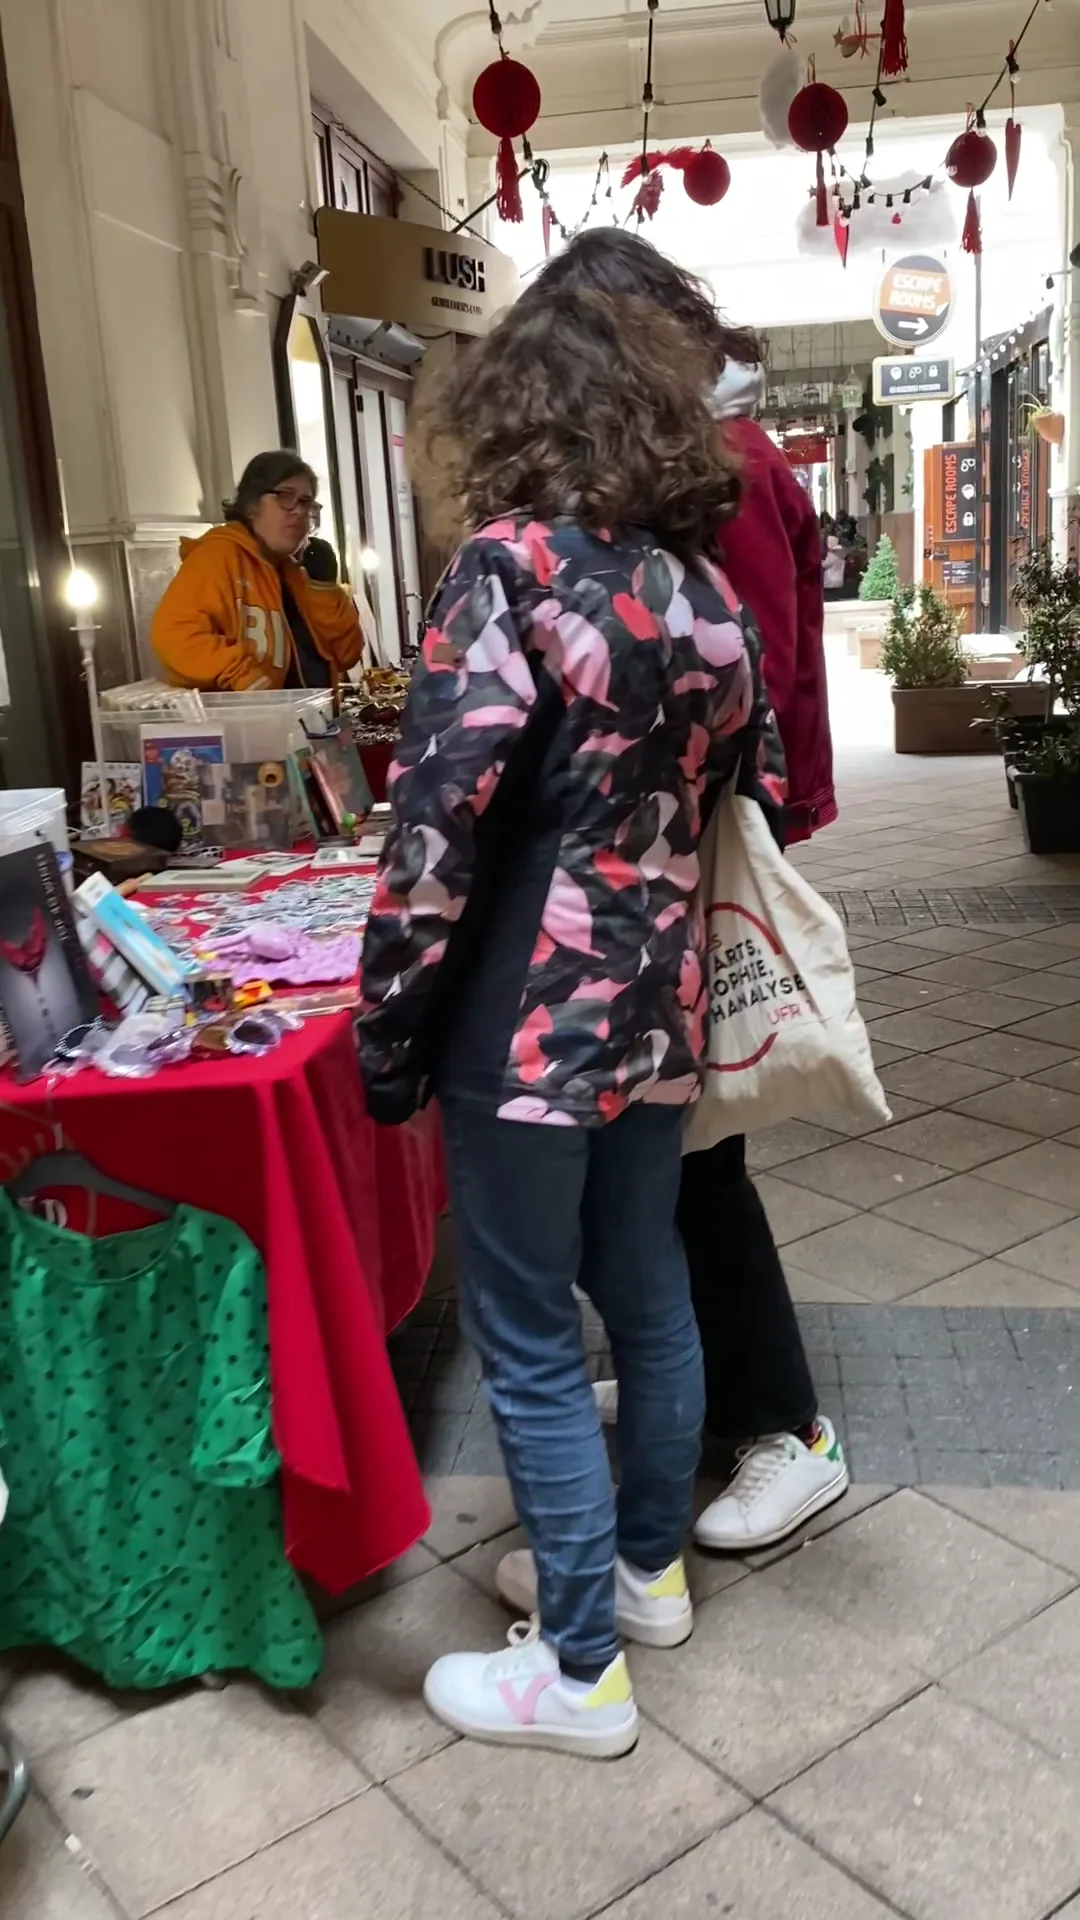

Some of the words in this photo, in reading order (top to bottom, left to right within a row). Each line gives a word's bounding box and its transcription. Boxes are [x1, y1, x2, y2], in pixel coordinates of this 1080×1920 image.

[423, 247, 486, 292] LUSH
[893, 273, 943, 294] ESCAPE
[889, 290, 937, 310] ROOMS
[945, 453, 957, 490] ROOMS
[945, 493, 957, 534] ESCAPE
[714, 938, 762, 973] ARTS,
[711, 959, 774, 997] OPHIE,
